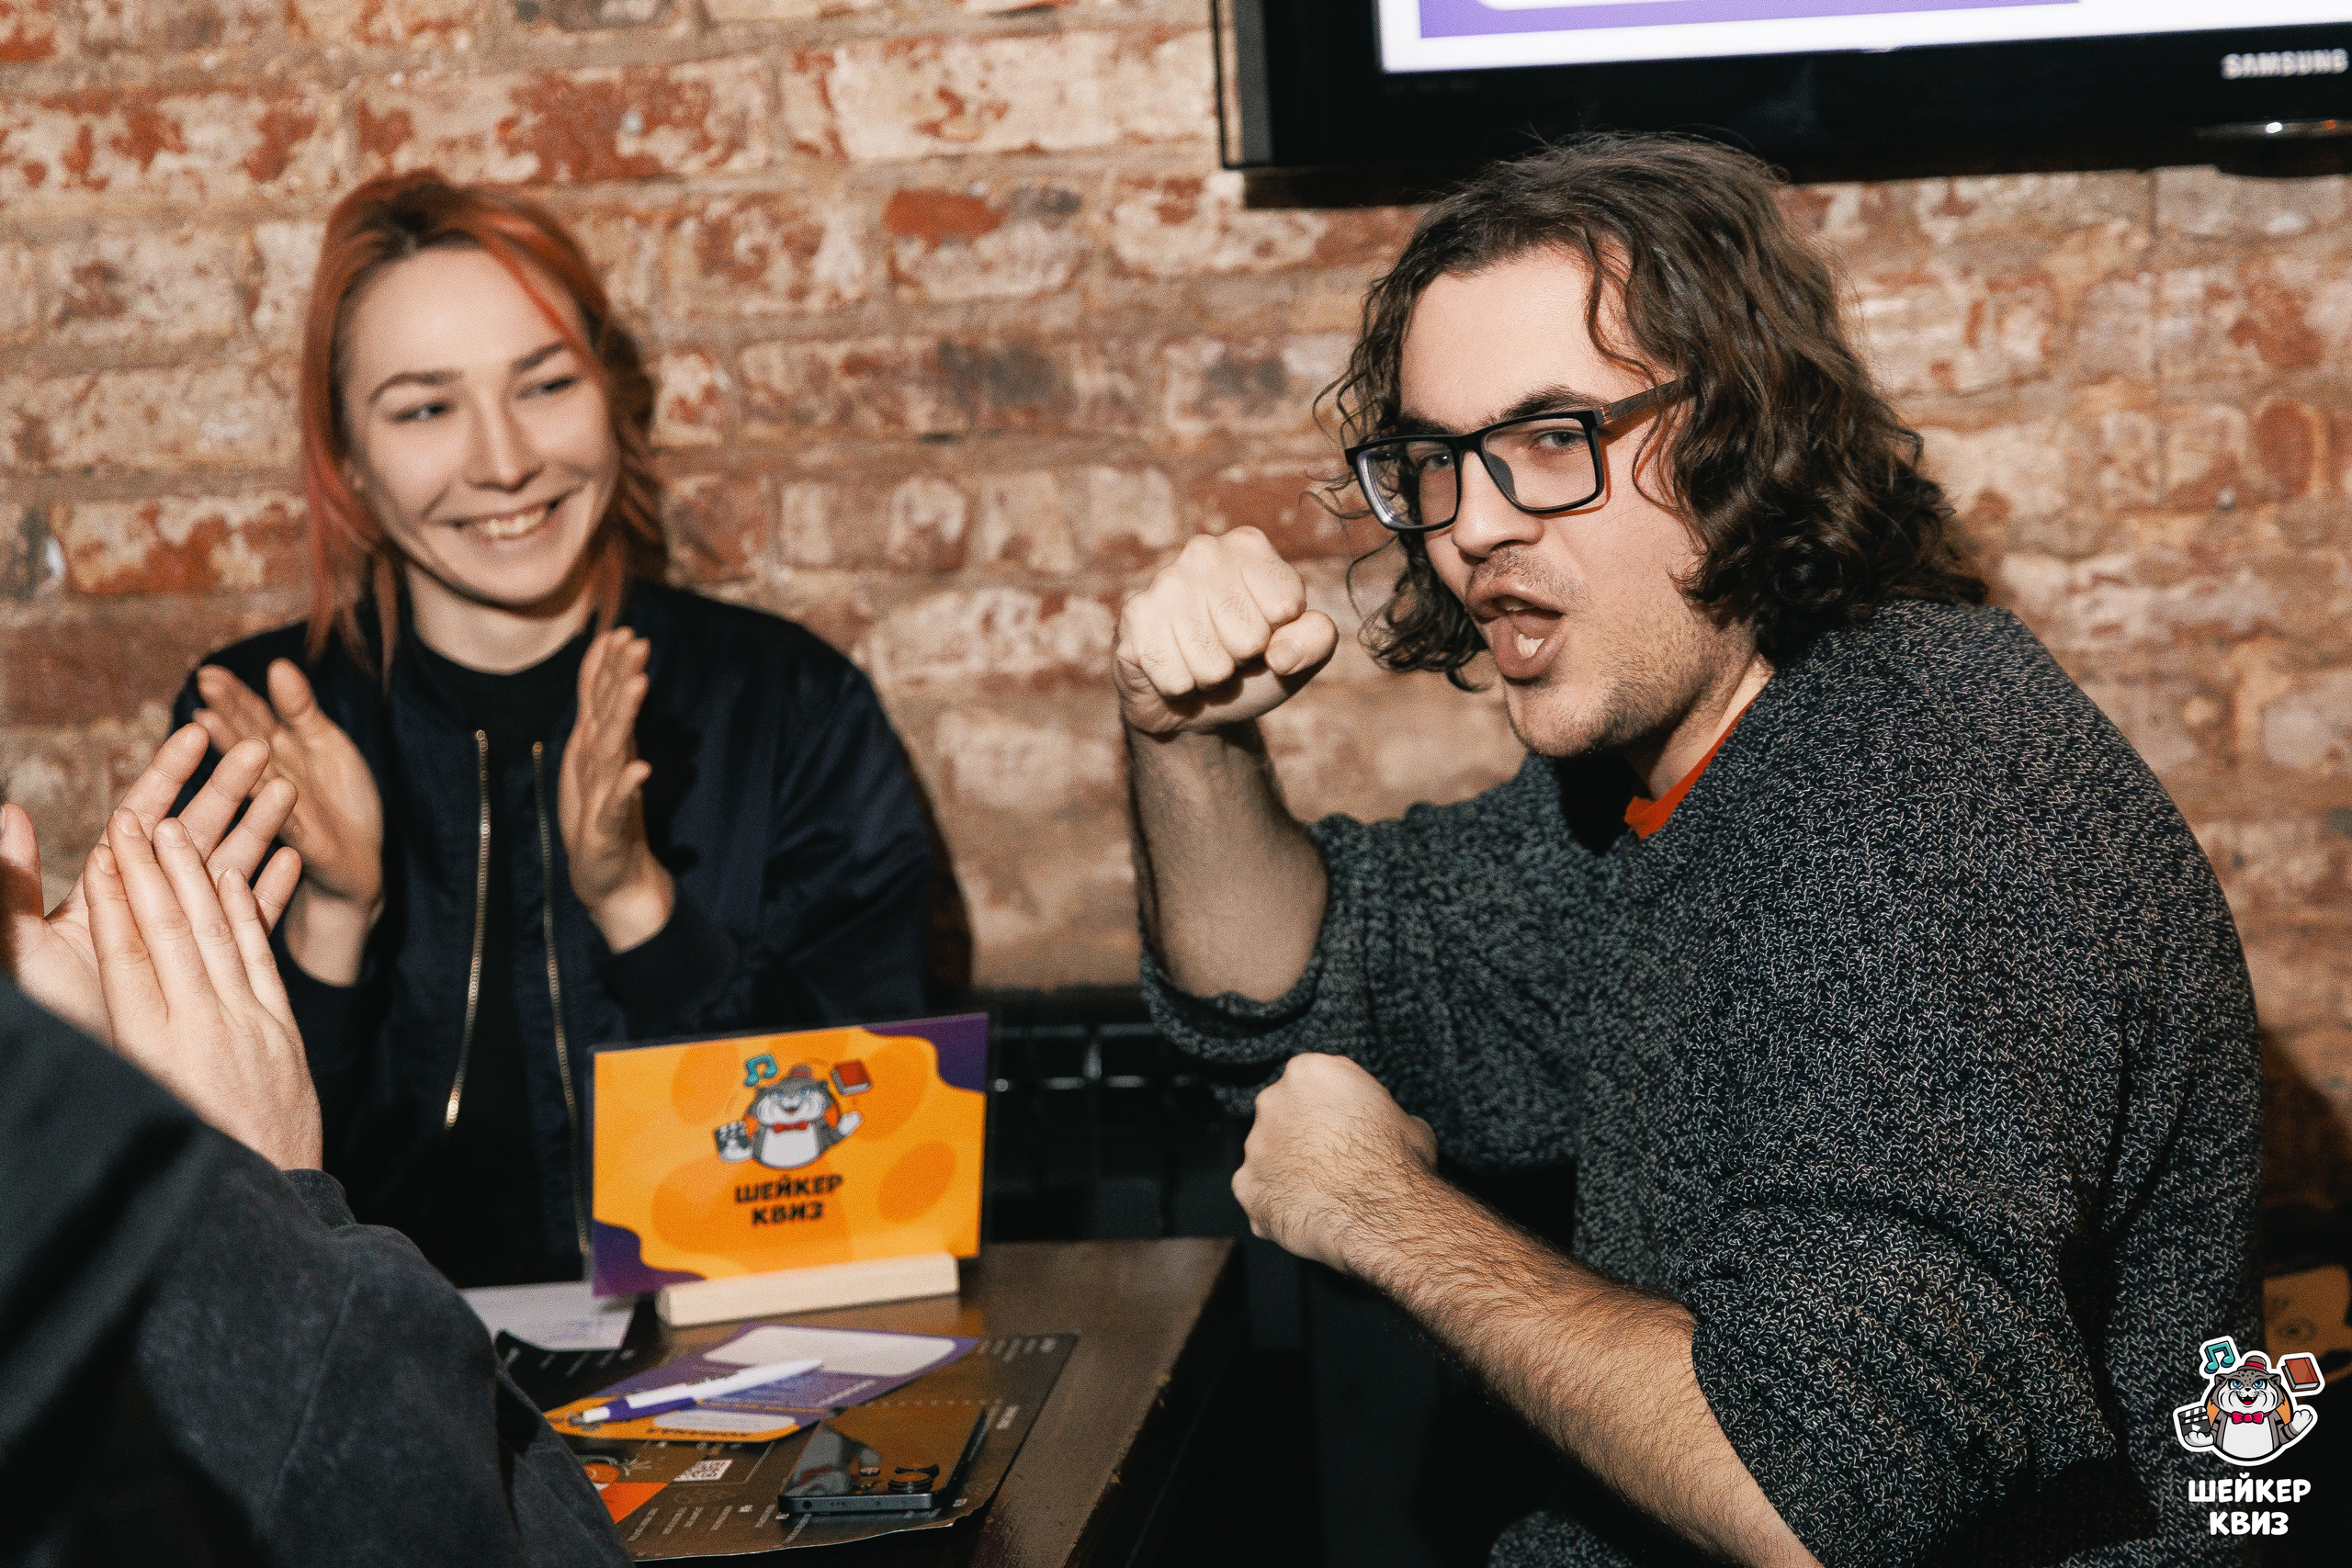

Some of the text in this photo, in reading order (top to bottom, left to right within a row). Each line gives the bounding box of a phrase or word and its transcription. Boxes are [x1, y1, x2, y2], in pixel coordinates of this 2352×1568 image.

[2221, 48, 2348, 79] SAMSUNG
[735, 1175, 842, 1203] ШЕЙКЕР
[752, 1201, 822, 1224] КВИЗ
